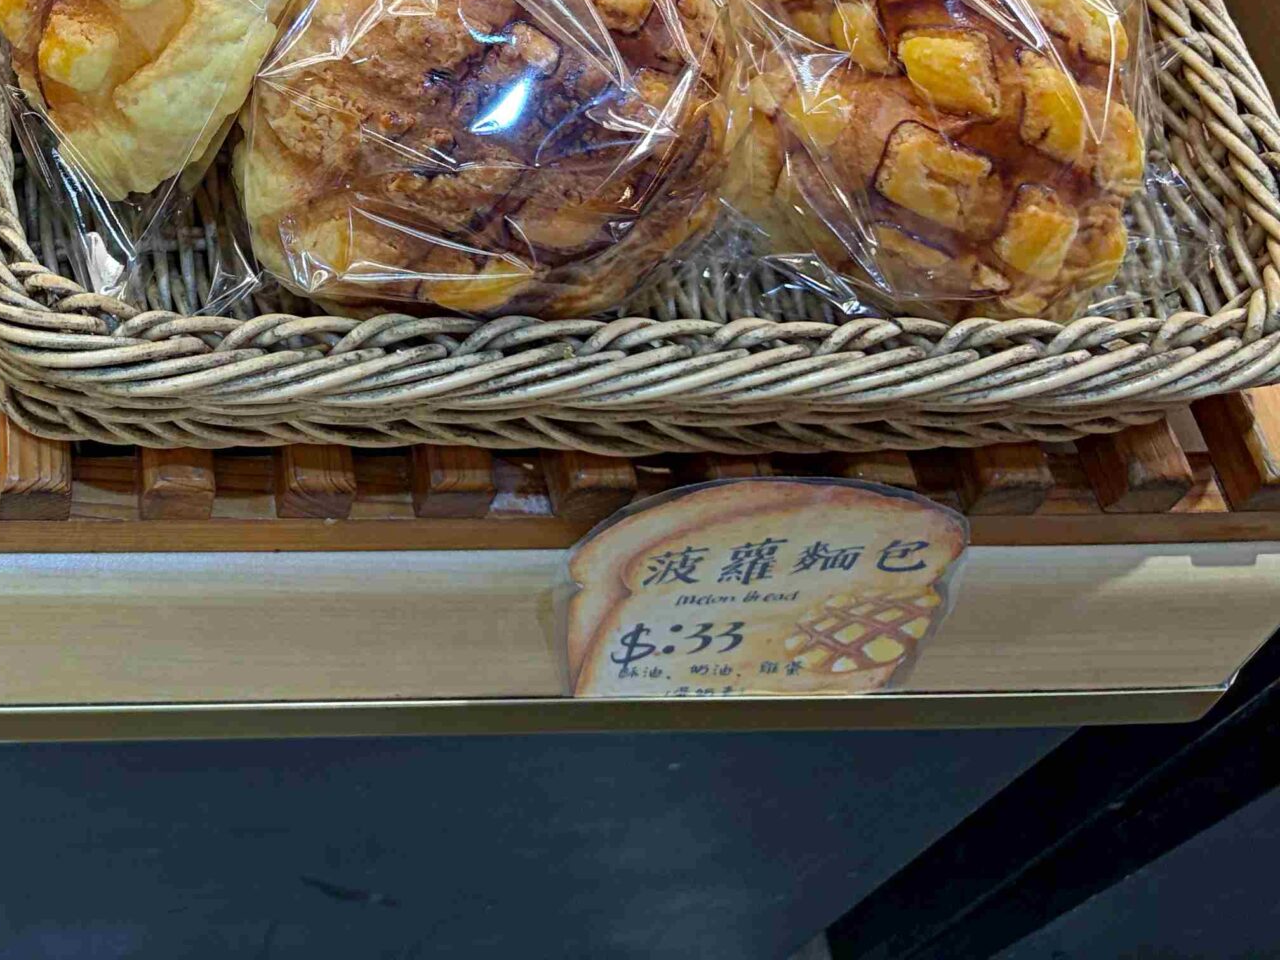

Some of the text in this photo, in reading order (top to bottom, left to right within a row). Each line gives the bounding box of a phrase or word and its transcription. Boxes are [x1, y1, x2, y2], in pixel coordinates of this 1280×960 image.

[642, 537, 930, 587] 菠蘿麵包
[742, 590, 800, 604] Bread
